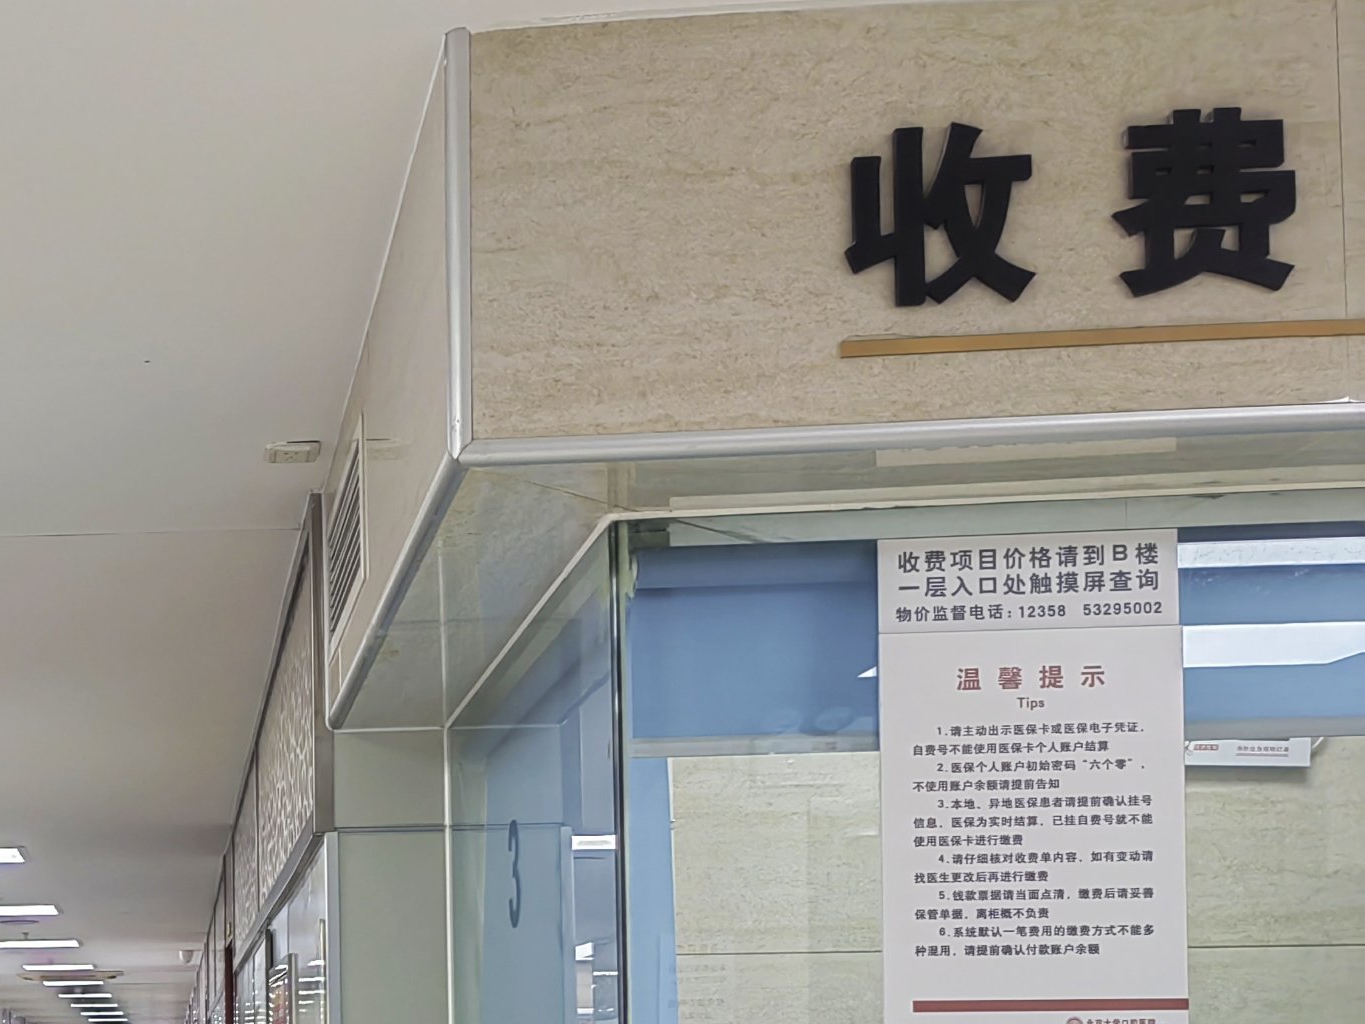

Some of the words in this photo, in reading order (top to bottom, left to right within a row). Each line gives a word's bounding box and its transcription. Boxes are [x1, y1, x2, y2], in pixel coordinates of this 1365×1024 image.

[844, 107, 1296, 307] 收费
[897, 542, 1159, 574] 收费项目价格请到B楼
[898, 568, 1159, 598] 一层入口处触摸屏查询
[1082, 601, 1163, 617] 53295002
[956, 665, 1105, 691] 温馨提示
[1017, 697, 1045, 711] Tips
